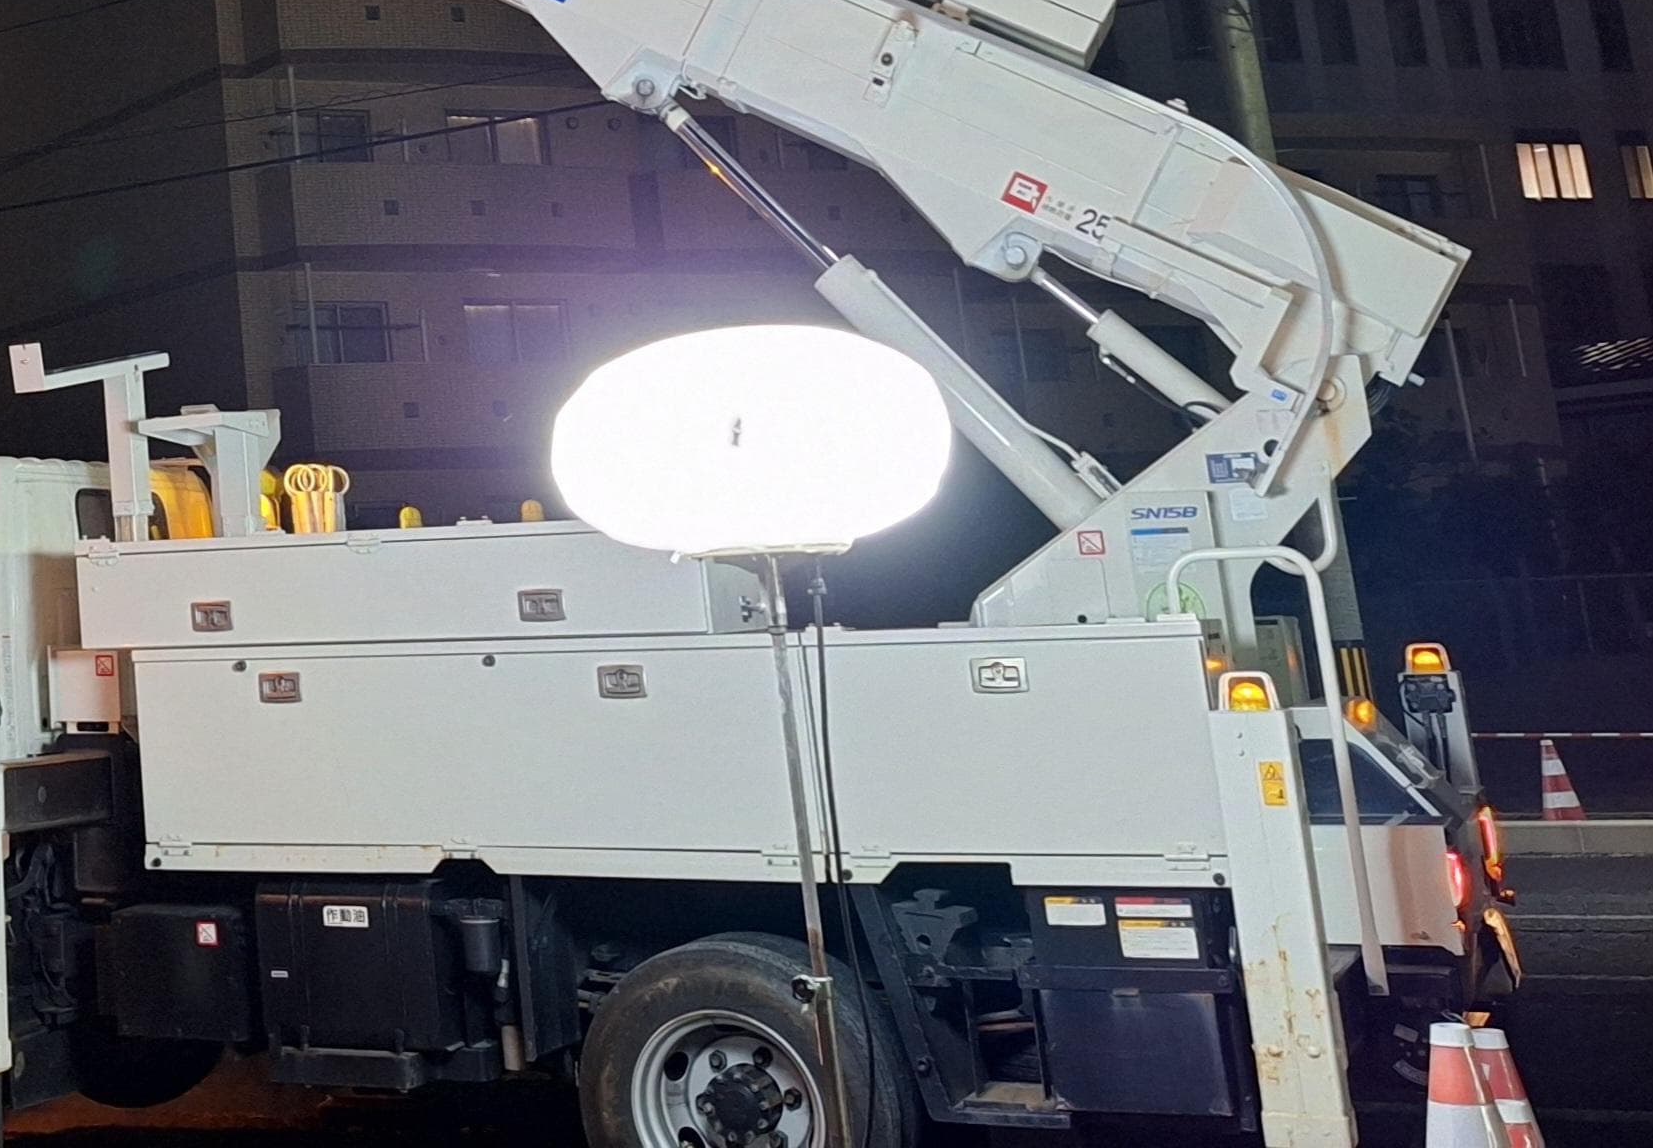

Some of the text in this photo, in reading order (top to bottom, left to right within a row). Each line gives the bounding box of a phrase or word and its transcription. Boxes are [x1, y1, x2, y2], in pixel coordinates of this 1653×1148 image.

[1131, 506, 1198, 520] SN15B
[327, 908, 365, 923] 作動油
